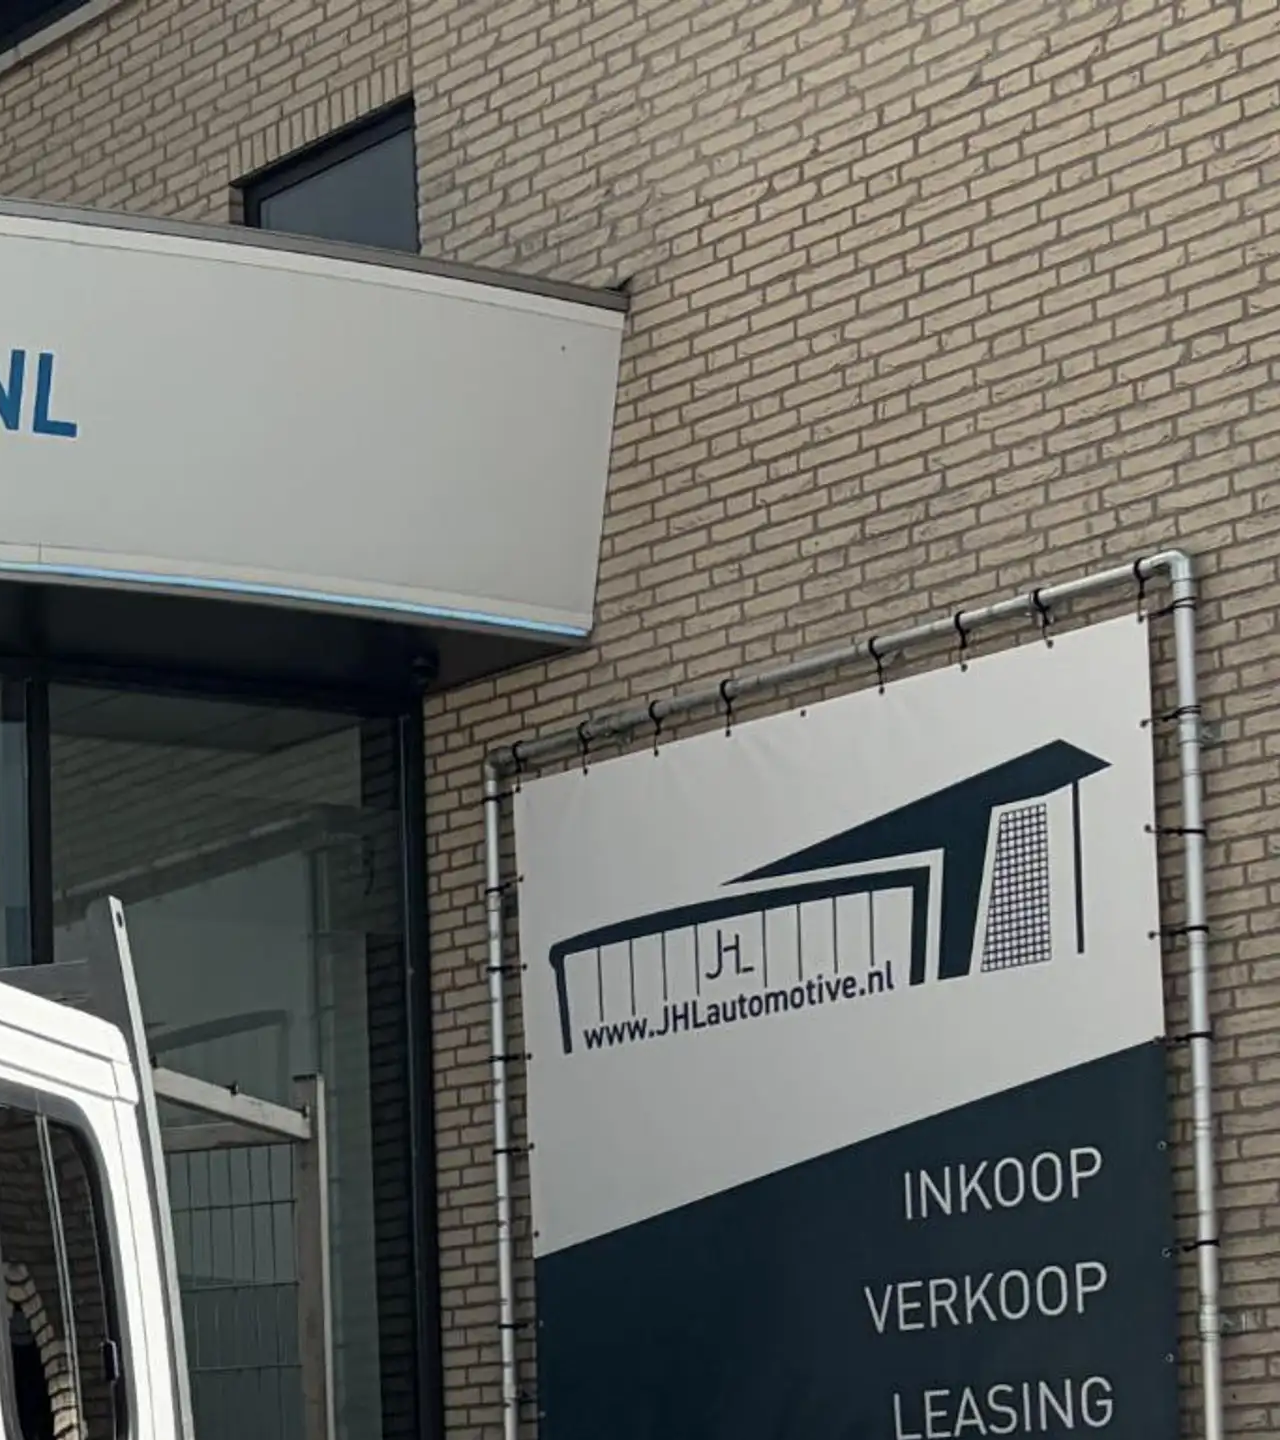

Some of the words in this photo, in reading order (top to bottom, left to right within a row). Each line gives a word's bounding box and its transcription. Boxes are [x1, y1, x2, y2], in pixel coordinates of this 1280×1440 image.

[583, 961, 895, 1050] www.JHLautomotive.nl
[904, 1146, 1103, 1221] INKOOP
[863, 1261, 1109, 1335] VERKOOP
